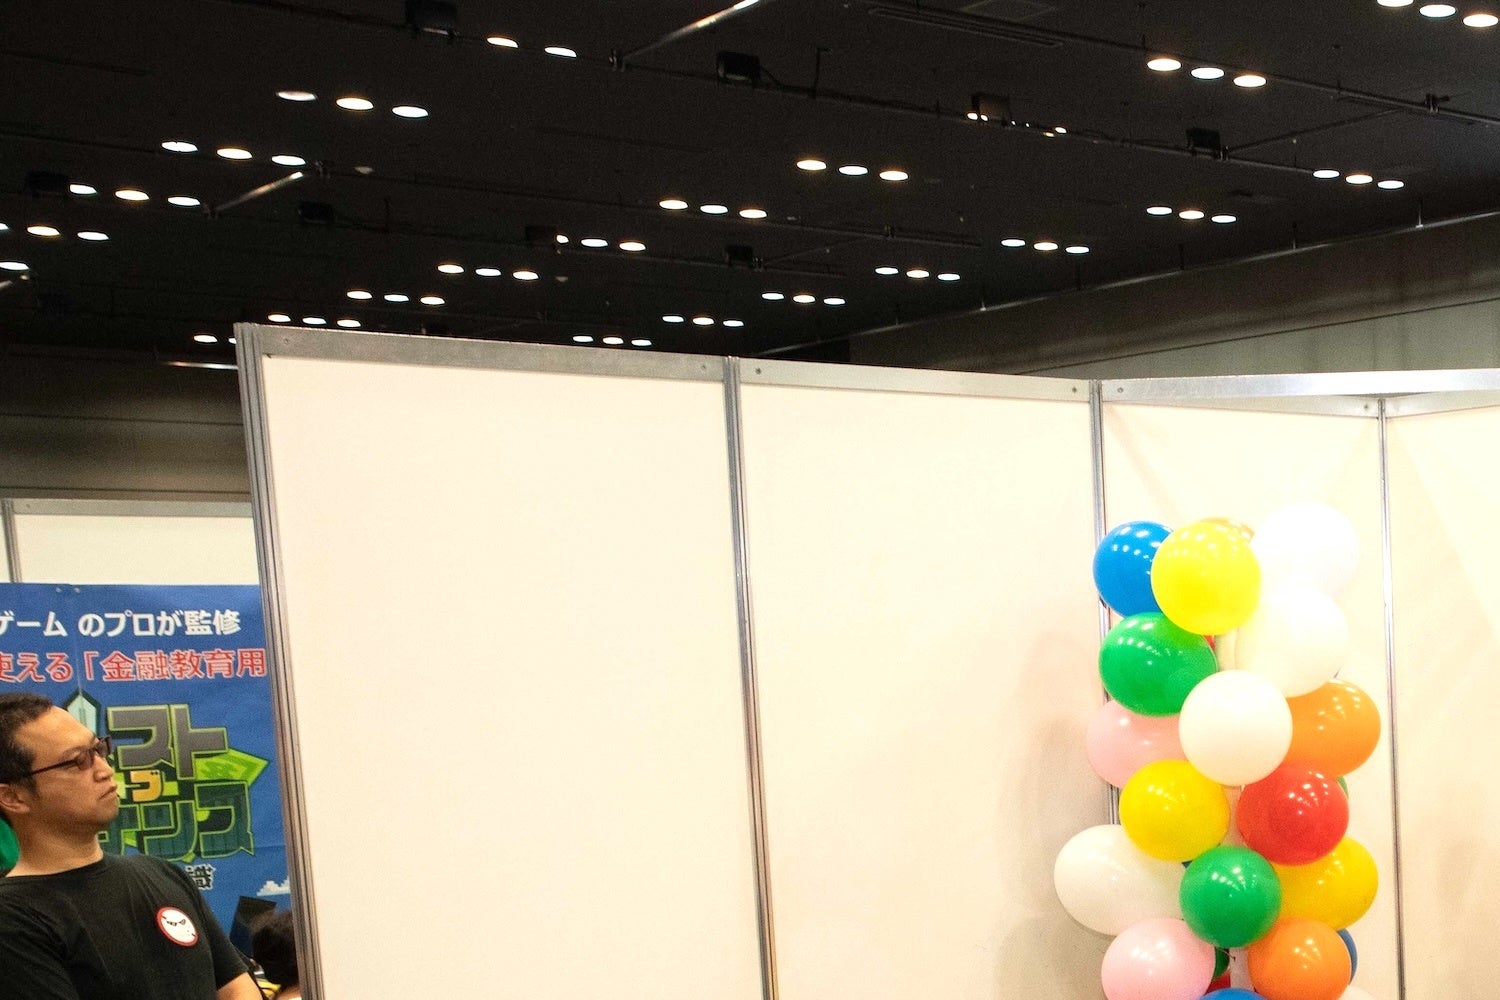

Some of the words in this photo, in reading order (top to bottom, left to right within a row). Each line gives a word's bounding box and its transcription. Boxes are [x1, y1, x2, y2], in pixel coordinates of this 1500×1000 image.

[78, 609, 241, 637] のプロが監修
